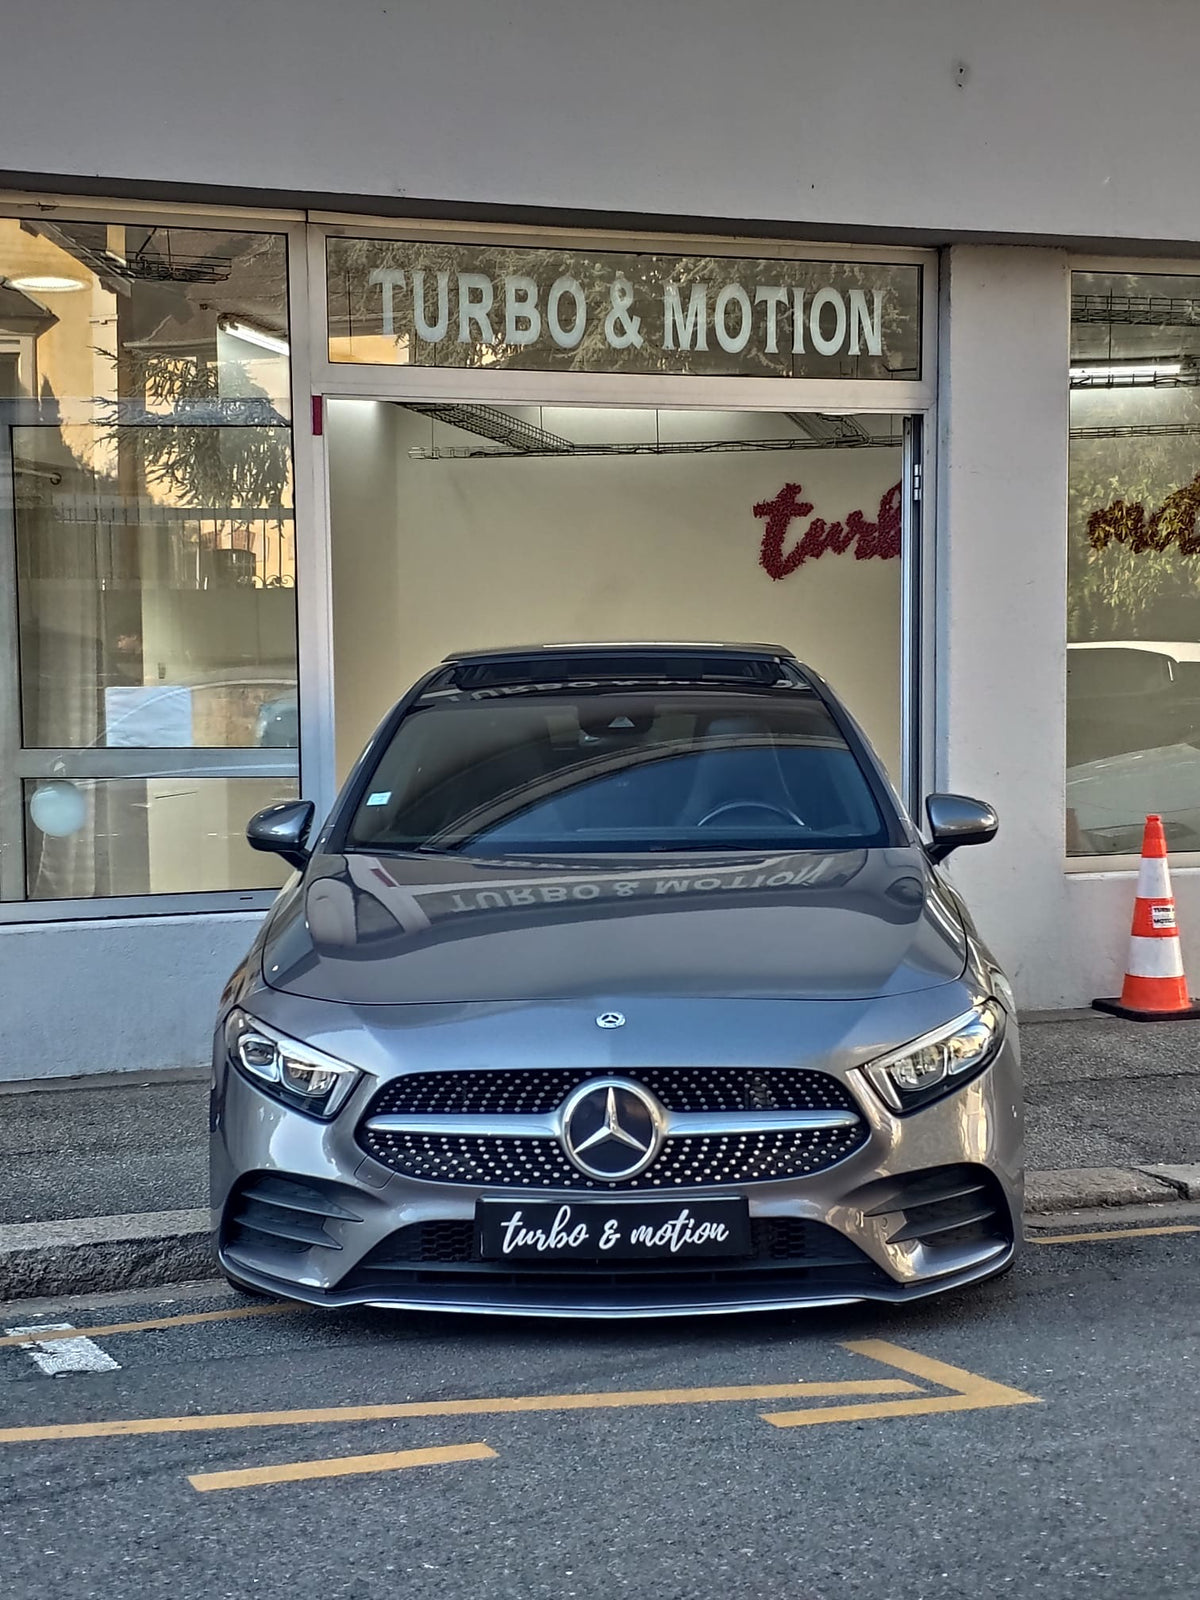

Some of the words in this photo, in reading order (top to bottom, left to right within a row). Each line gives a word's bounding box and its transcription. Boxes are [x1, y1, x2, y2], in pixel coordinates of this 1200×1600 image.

[369, 268, 587, 349] TURBO
[604, 274, 645, 349] &
[661, 282, 887, 357] MOTION
[500, 1204, 589, 1254] turbo
[598, 1218, 621, 1250] &
[630, 1208, 730, 1253] motion
